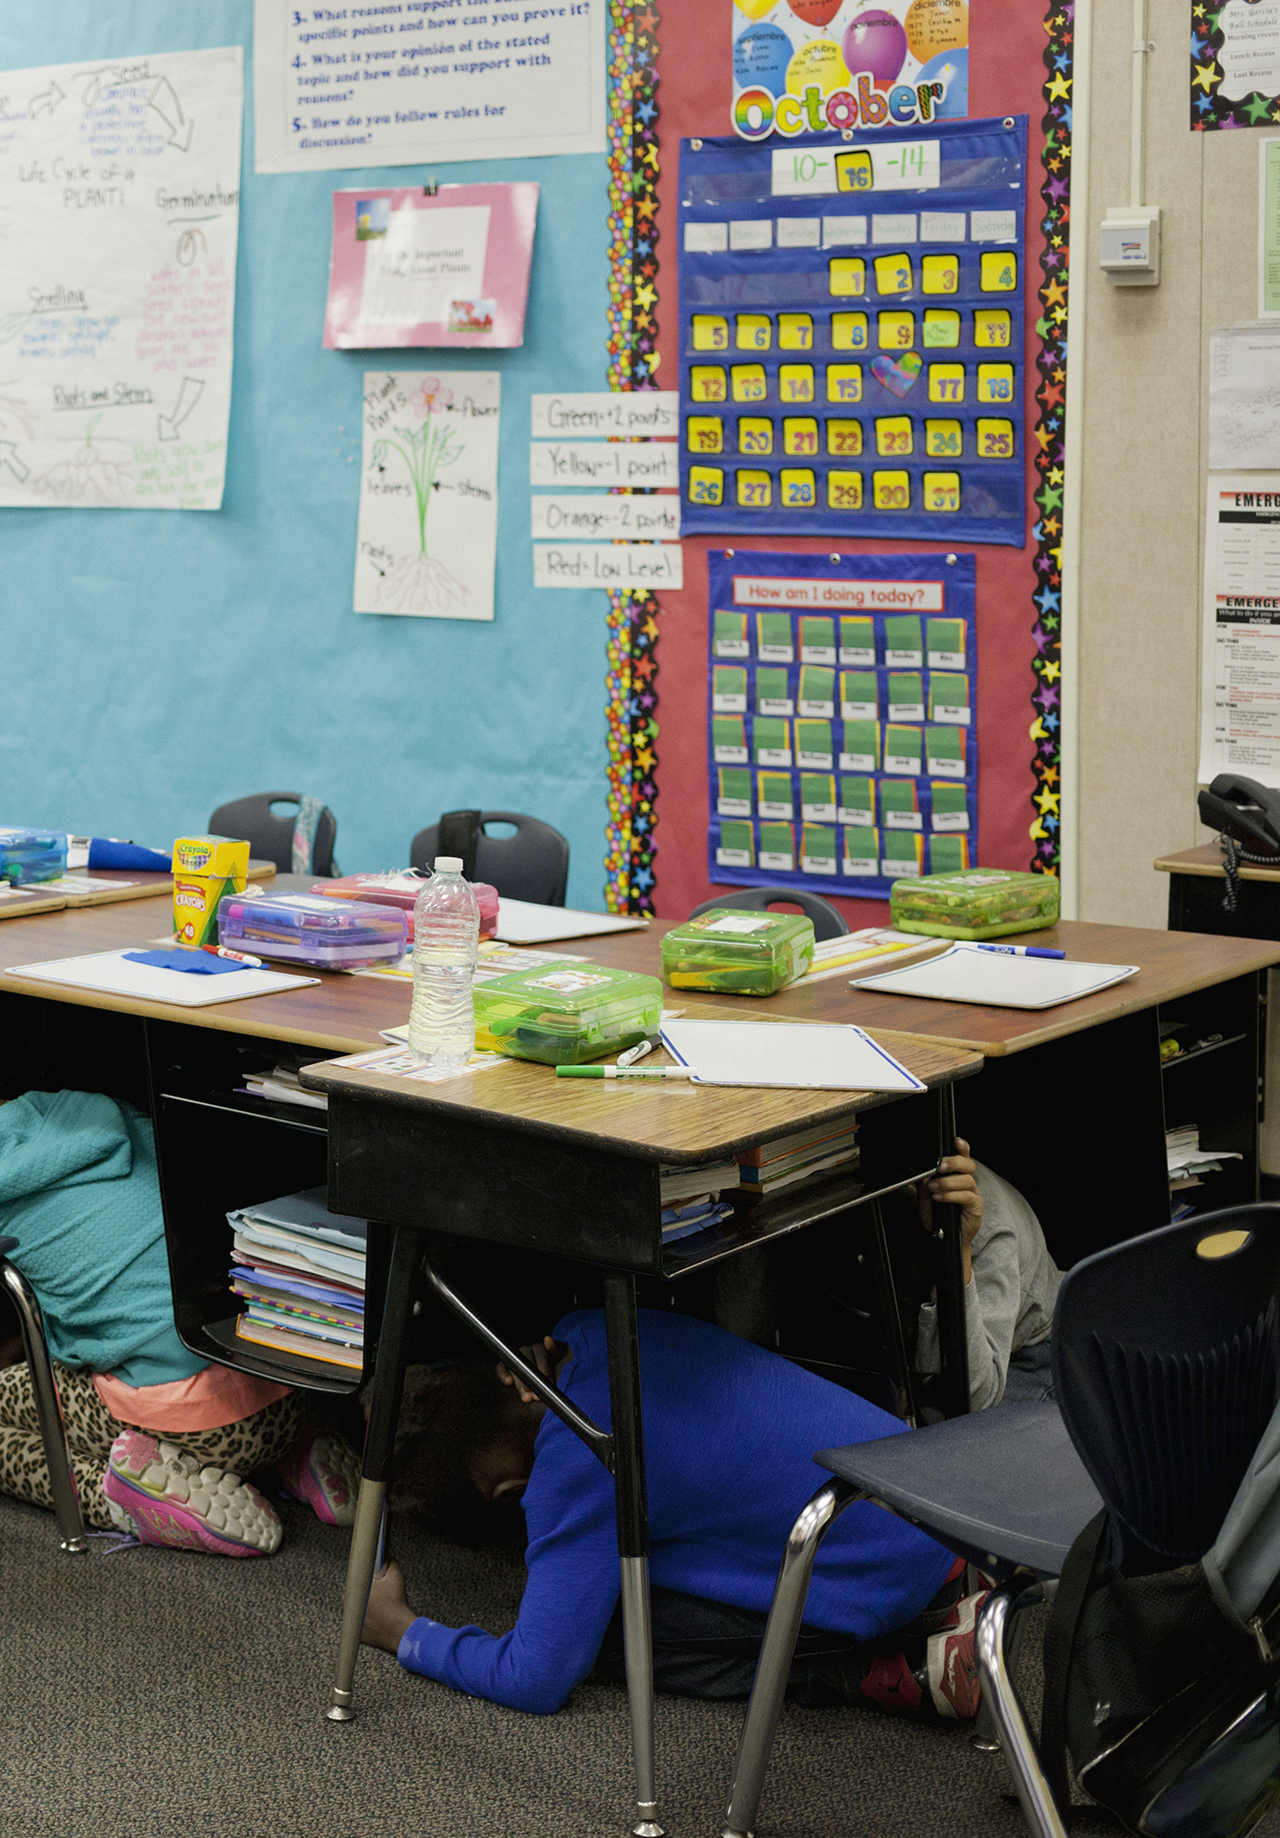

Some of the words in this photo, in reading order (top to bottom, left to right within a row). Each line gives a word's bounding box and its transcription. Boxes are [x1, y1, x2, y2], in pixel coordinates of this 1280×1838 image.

[314, 9, 347, 21] What
[352, 5, 402, 18] reasons
[353, 22, 394, 38] points
[400, 20, 424, 32] and
[428, 17, 457, 30] how
[463, 15, 488, 25] can
[492, 13, 519, 25] you
[524, 8, 566, 22] prove
[571, 2, 589, 15] it?
[850, 17, 899, 31] noviembre
[312, 52, 347, 66] What
[351, 51, 361, 63] is
[366, 49, 396, 63] your
[402, 43, 454, 60] opinion
[459, 40, 472, 53] of
[477, 38, 500, 51] the
[505, 33, 550, 49] stated
[803, 45, 837, 56] octubre
[336, 70, 360, 84] and
[363, 67, 391, 81] how
[423, 64, 449, 78] you
[454, 57, 510, 74] support
[516, 53, 551, 67] with
[1233, 71, 1248, 79] Last
[1249, 69, 1272, 77] Recess
[735, 75, 944, 136] October
[292, 117, 307, 132] 5.
[366, 114, 391, 128] you
[396, 109, 438, 124] follow
[444, 106, 480, 120] rules
[484, 104, 506, 118] for
[851, 272, 862, 292] 1
[896, 268, 909, 289] 2
[942, 269, 955, 291] 3
[999, 266, 1013, 287] 4
[712, 327, 724, 346] 5
[755, 327, 766, 346] 6
[797, 326, 810, 345] 7
[851, 326, 864, 346] 8
[897, 325, 910, 345] 9
[701, 378, 722, 399] 12
[788, 378, 810, 399] 14
[836, 379, 858, 399] 15
[937, 379, 961, 399] 17
[987, 378, 1009, 399] 18
[744, 431, 769, 450] 20
[794, 432, 814, 451] 21
[835, 432, 858, 451] 22
[883, 432, 909, 452] 23
[933, 433, 958, 453] 24
[984, 433, 1010, 454] 25
[627, 451, 667, 479] point
[695, 480, 719, 501] 26
[744, 483, 768, 503] 27
[788, 483, 812, 502] 28
[834, 485, 858, 506] 29
[879, 485, 906, 505] 30
[933, 487, 957, 508] 31
[749, 585, 781, 599] How
[786, 588, 808, 600] am
[813, 587, 817, 600] I
[823, 587, 864, 606] doing
[871, 589, 924, 606] today?
[180, 844, 209, 855] Crayola
[176, 893, 206, 912] CRAYONS
[184, 924, 195, 938] 48
